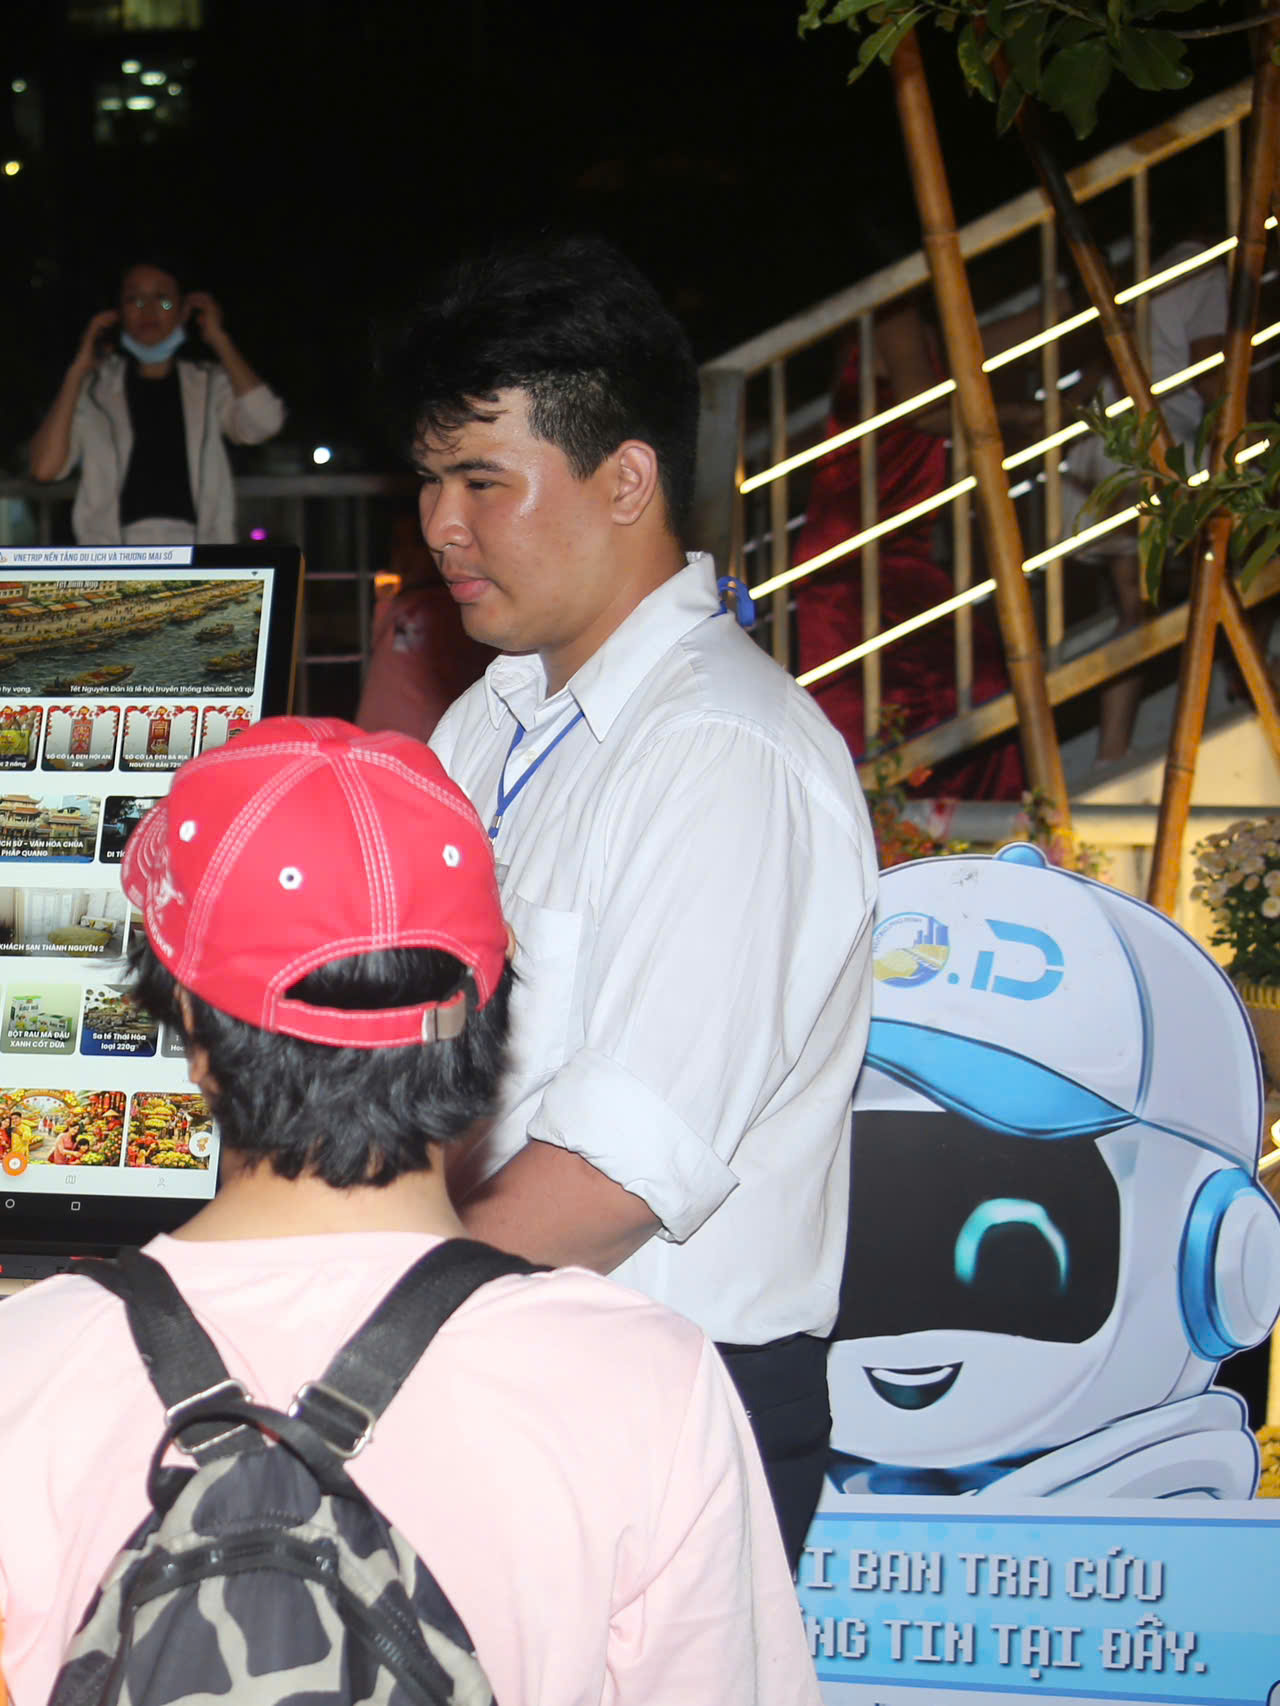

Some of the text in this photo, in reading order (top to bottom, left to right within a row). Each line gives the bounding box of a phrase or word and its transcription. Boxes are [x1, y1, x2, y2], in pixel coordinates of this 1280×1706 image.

[92, 1032, 102, 1040] Sa
[10, 1040, 31, 1048] XANH
[116, 1043, 136, 1052] 220g
[804, 1546, 1165, 1601] I BAN TRA CỨU
[803, 1607, 1208, 1680] NG TIN TẠI ĐÂY.
